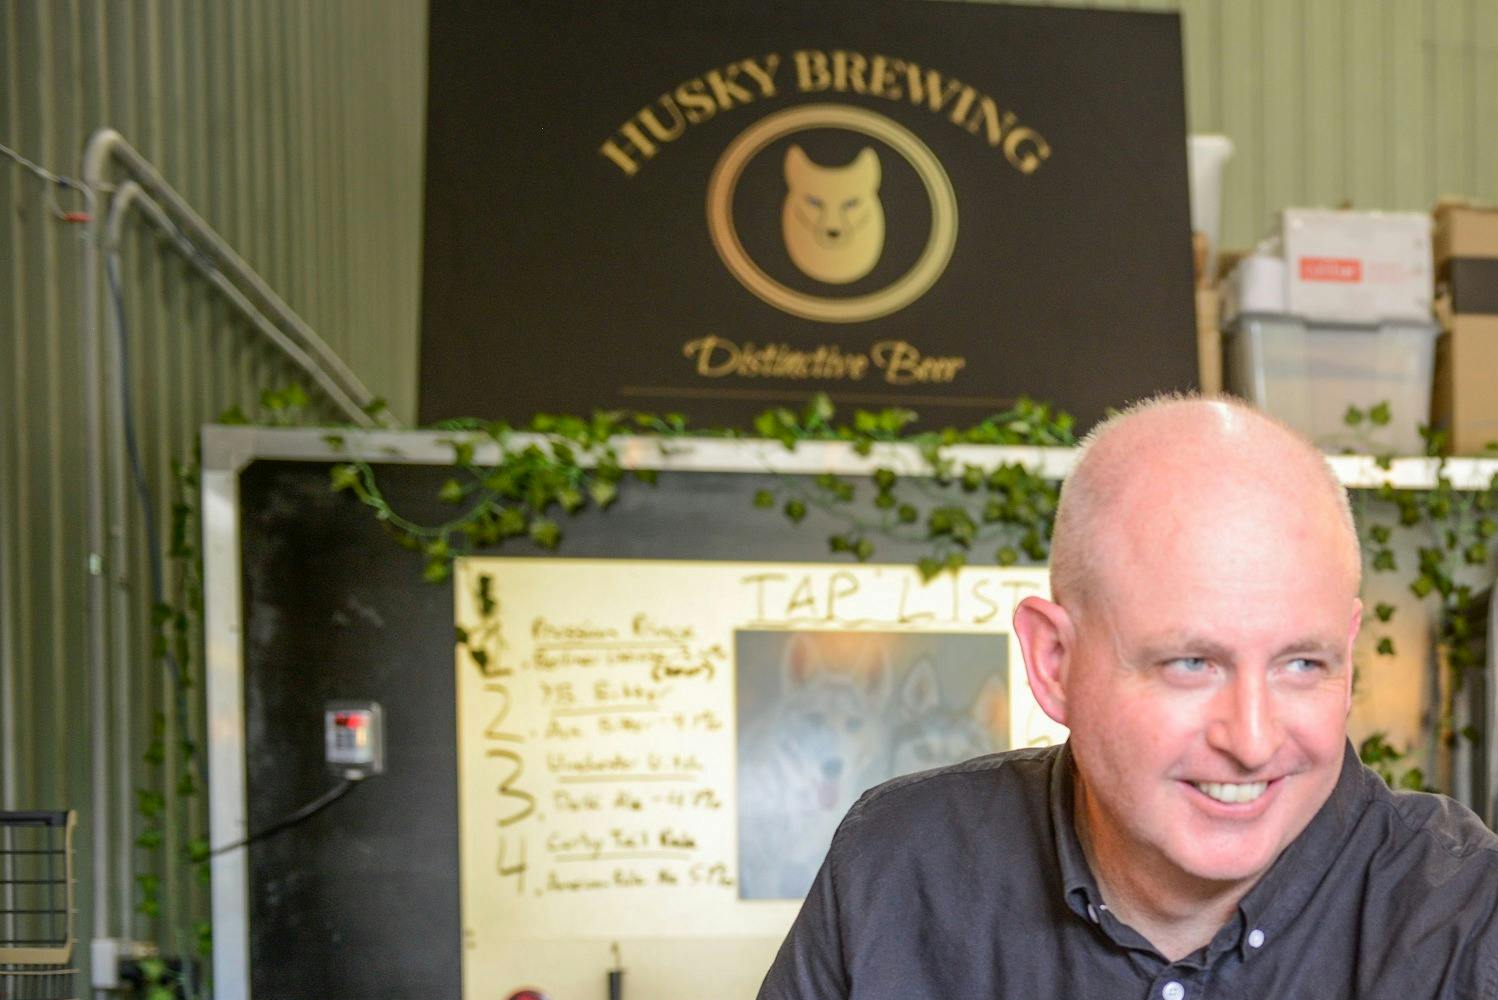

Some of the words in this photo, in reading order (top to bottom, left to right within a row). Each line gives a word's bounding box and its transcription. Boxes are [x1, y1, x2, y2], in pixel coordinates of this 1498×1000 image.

[600, 52, 780, 177] HUSKY
[794, 50, 1051, 175] BREWING
[683, 335, 869, 382] Distinctive
[871, 341, 967, 385] Beer
[740, 571, 860, 622] TAP
